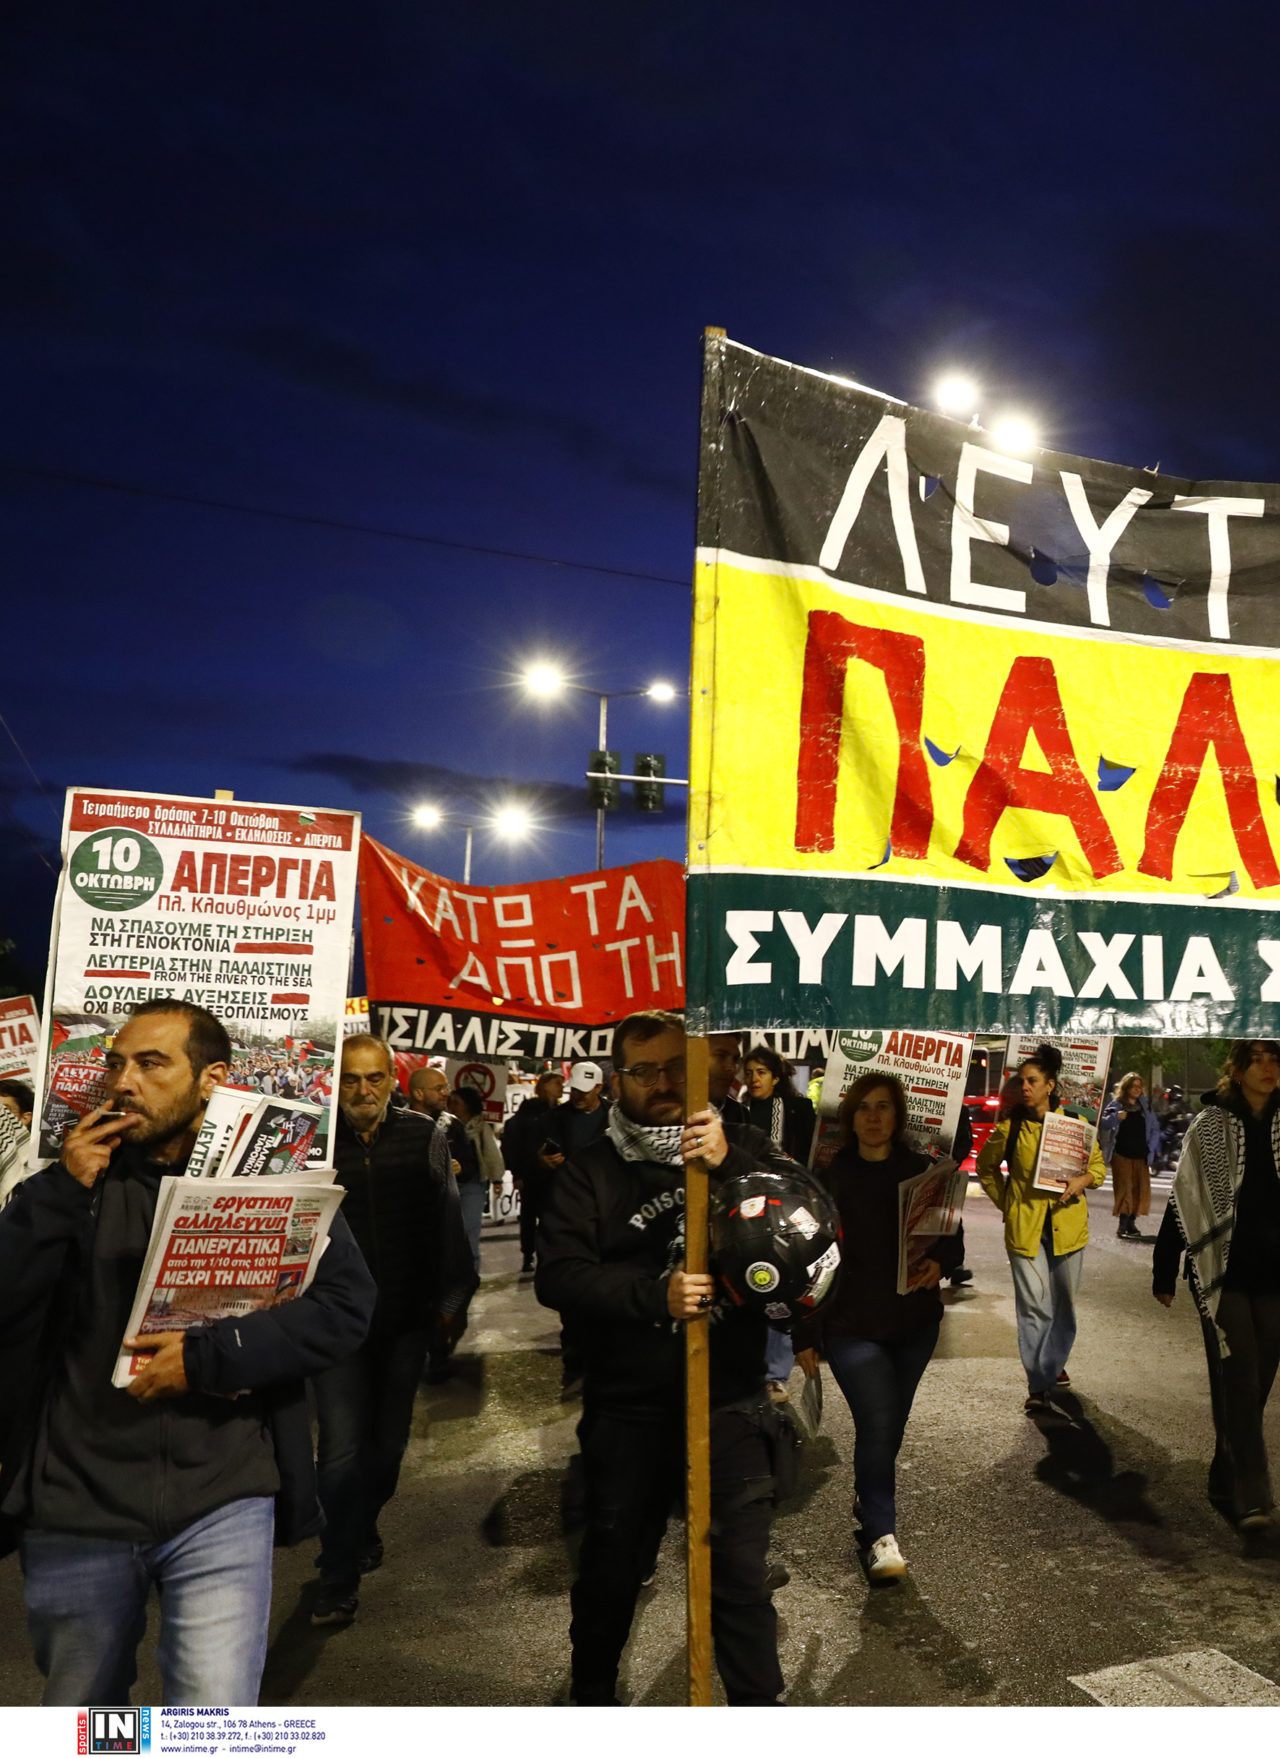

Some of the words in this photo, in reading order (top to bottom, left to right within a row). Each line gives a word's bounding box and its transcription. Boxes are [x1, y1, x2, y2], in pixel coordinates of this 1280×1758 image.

[82, 800, 150, 819] Τετραήμερο
[154, 805, 197, 824] δράσης
[201, 809, 227, 825] 7-10
[230, 812, 280, 830] Οκτώβρη
[147, 821, 222, 839] ΣΥΛΛΑΛΗΤΗΡΙΑ
[235, 828, 293, 845] ΕΚΔΗΛΩΣΕΙΣ
[304, 833, 342, 848] ΑΠΕΡΓΙΑ
[92, 836, 141, 872] 10
[75, 872, 155, 891] ΟΚΤΩΒΡΗ
[170, 850, 336, 901] ΑΠΕΡΓΙΑ
[158, 895, 185, 912] Πλ.
[192, 897, 301, 921] Κλαυθμώνος
[306, 904, 336, 924] 1μμ
[401, 868, 536, 948] ΚΑΤΩ
[570, 874, 654, 936] ΤΑ
[91, 917, 115, 932] ΝΑ
[119, 919, 212, 937] ΣΠΑΣΟΥΜΕ
[216, 924, 238, 939] ΤΗ
[242, 926, 313, 942] ΣΤΗΡΙΞΗ
[89, 933, 122, 947] ΣΤΗ
[126, 934, 231, 953] ΓΕΝΟΚΤΟΝΙΑ
[87, 954, 165, 970] ΛΕΥΤΕΡΙΑ
[169, 958, 212, 973] ΣΤΗΝ
[219, 960, 312, 977] ΠΑΛΑΙΣΤΙΝΗ
[725, 910, 1235, 1002] ΣΥΜΜΑΧΙΑ
[154, 971, 187, 982] FROM
[190, 973, 212, 983] THE
[215, 974, 248, 985] RIVER
[251, 975, 266, 986] TO
[268, 976, 290, 987] THE
[292, 977, 313, 988] SEA
[449, 951, 584, 1009] ΑΠΟ
[84, 985, 175, 1001] ΔΟΥΛΕΙΕΣ
[183, 989, 268, 1006] ΑΥΞΗΣΕΙΣ
[83, 1001, 108, 1014] ΟΧΙ
[841, 1037, 878, 1052] ΟΚΤΩΒΡΗ
[885, 1031, 963, 1068] ΑΠΕΡΓΙΑ
[59, 1067, 106, 1081] ΛΕΥΤΕ
[845, 1064, 857, 1073] ΝΑ
[904, 1074, 915, 1084] ΤΗ
[915, 1076, 949, 1090] ΣΤΗΡΙΞΗ
[213, 1196, 293, 1213] εργατικη
[174, 1213, 288, 1233] αλληλεγγυη
[171, 1238, 280, 1254] ΠΑΝΕΡΓΑΤΙΚΑ
[167, 1257, 188, 1267] από
[190, 1259, 207, 1269] την
[209, 1257, 230, 1268] 1/10
[253, 1257, 278, 1267] 10/10
[162, 1270, 212, 1285] ΜΕΧΡΙ
[214, 1270, 233, 1285] ΤΗ
[236, 1270, 278, 1285] ΝΙΚΗ!
